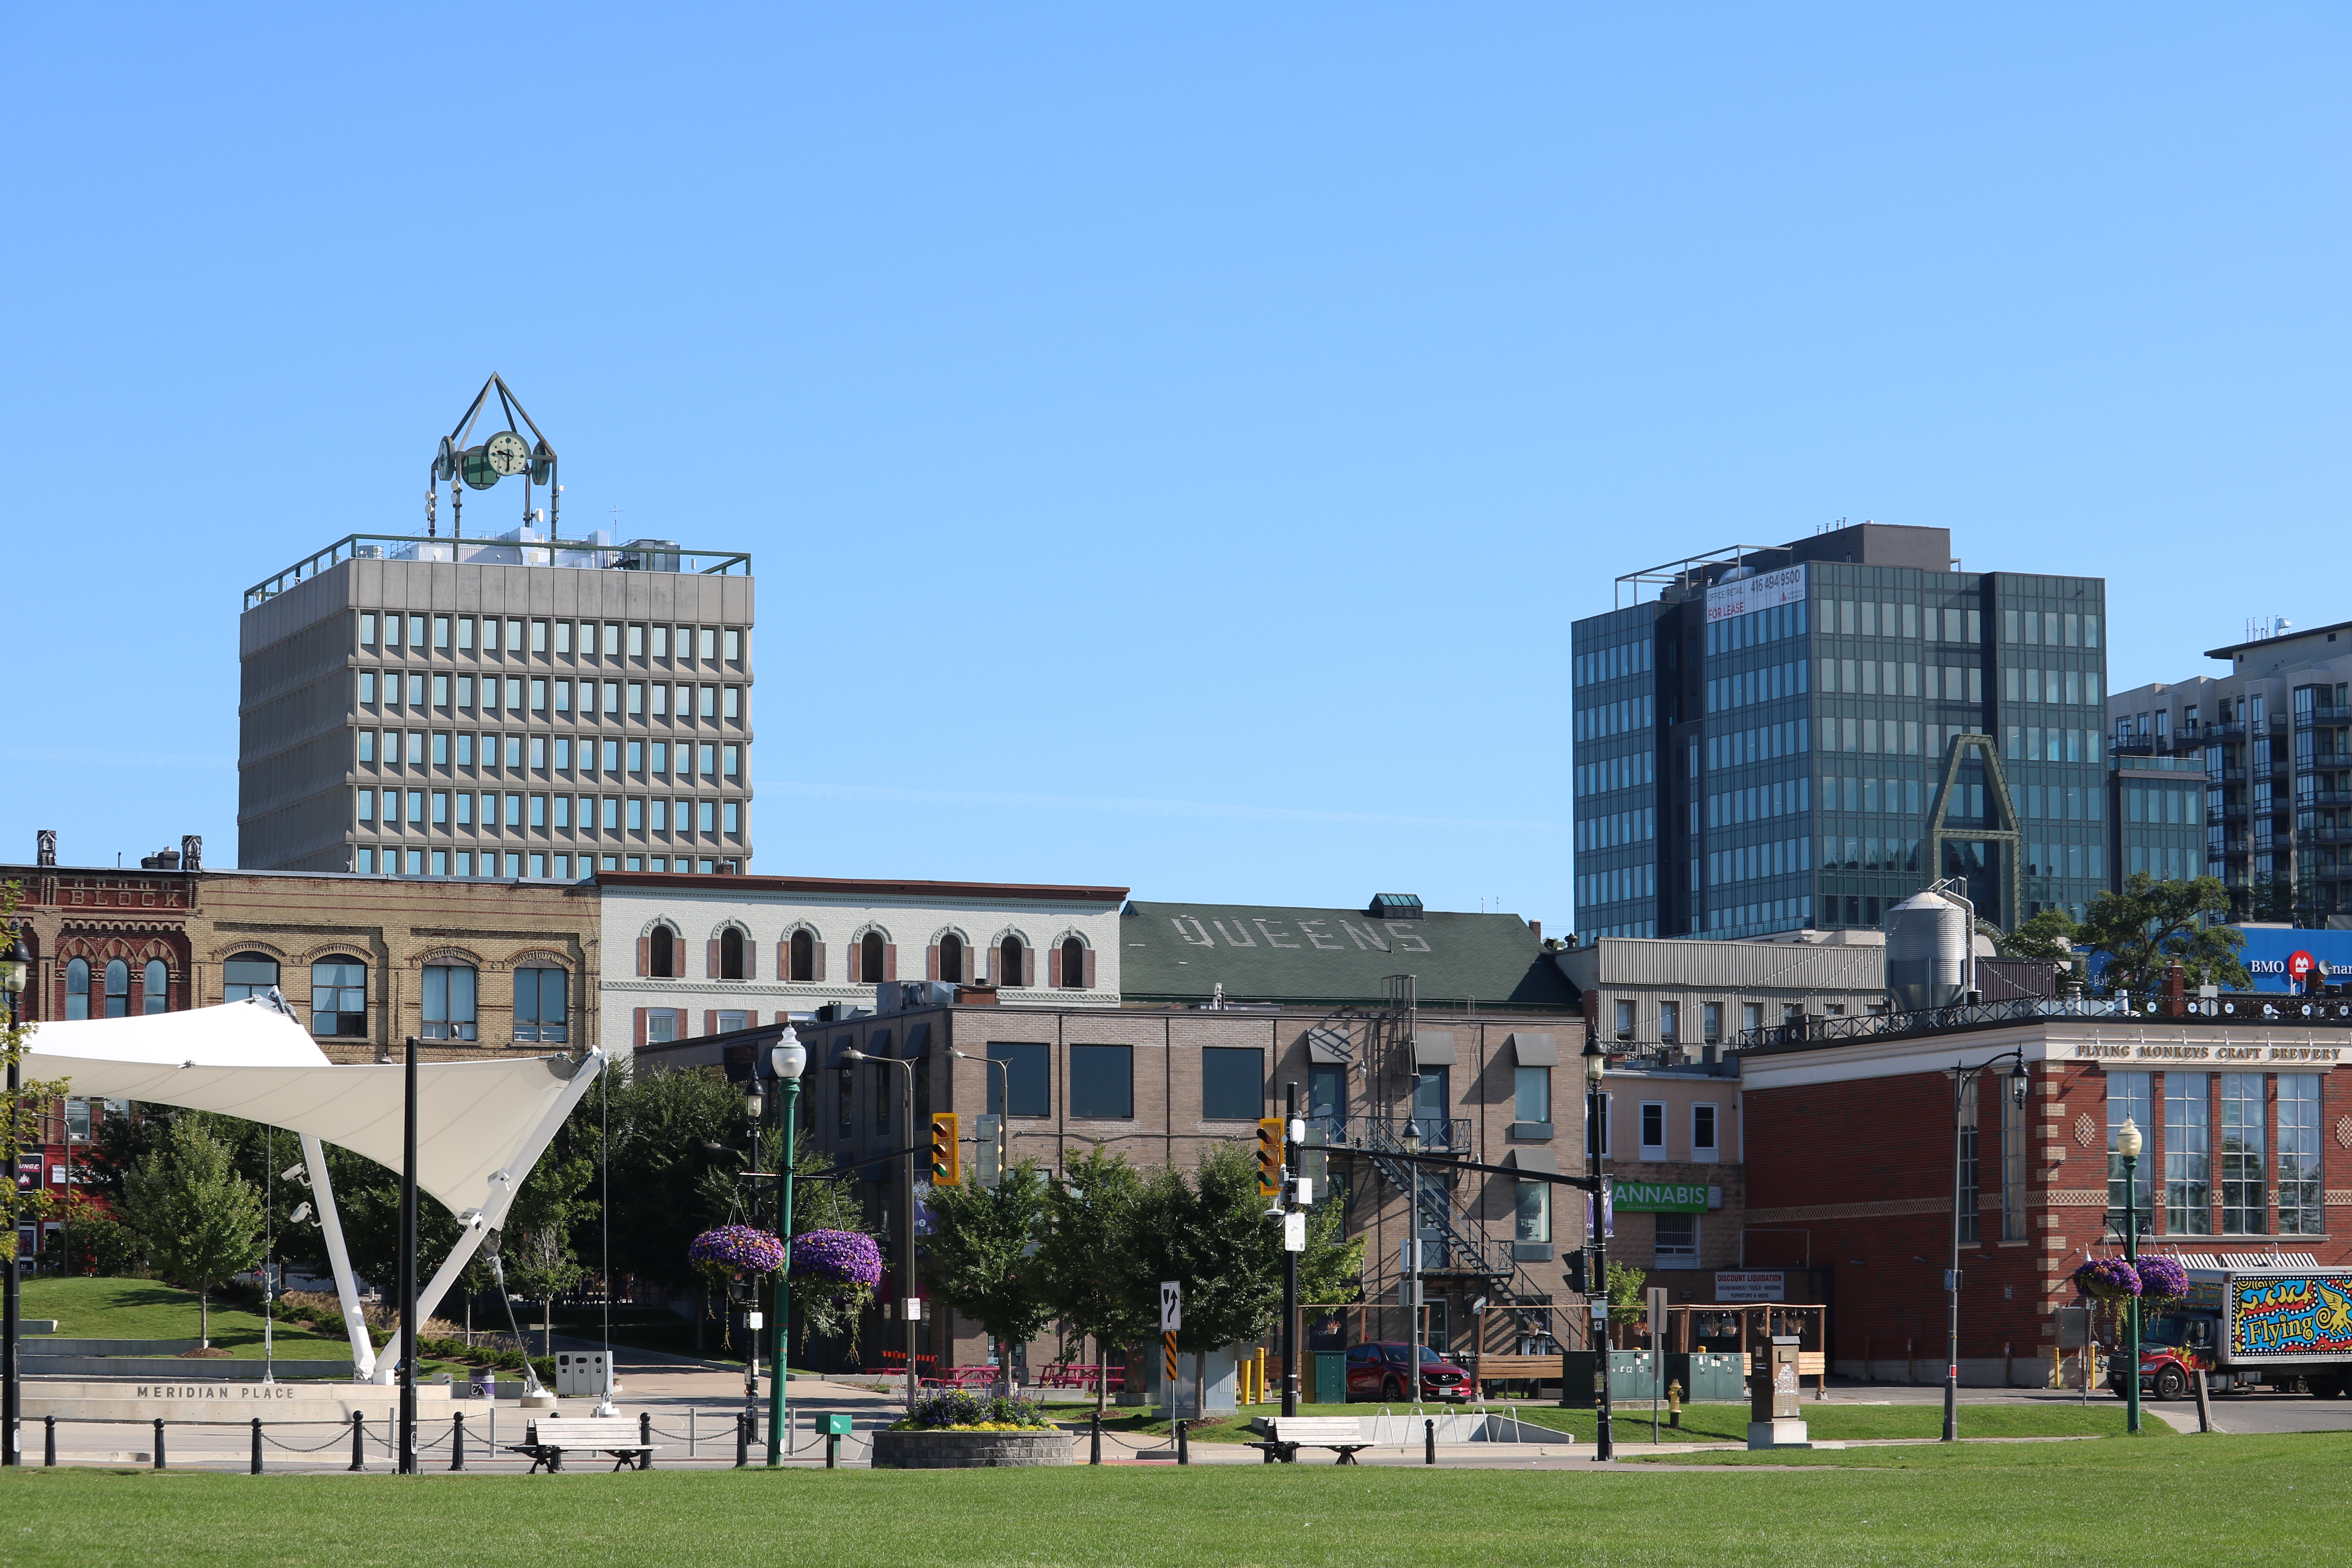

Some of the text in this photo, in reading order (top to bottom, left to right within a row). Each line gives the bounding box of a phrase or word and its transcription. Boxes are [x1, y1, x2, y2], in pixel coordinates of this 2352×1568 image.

[1708, 569, 1800, 601] OFFICE/RETAIL 416 494 9500
[1708, 602, 1744, 620] FOR LEASE
[71, 890, 178, 907] BLOCK
[1171, 915, 1431, 952] QUEENS
[2251, 960, 2285, 973] BMO
[2078, 1045, 2341, 1059] FLYING MONKEYS CRAFT BREWERY
[1613, 1185, 1705, 1204] ANNABIS
[2248, 1314, 2314, 1347] Flying
[137, 1387, 293, 1399] MERIDIAN PLACE
